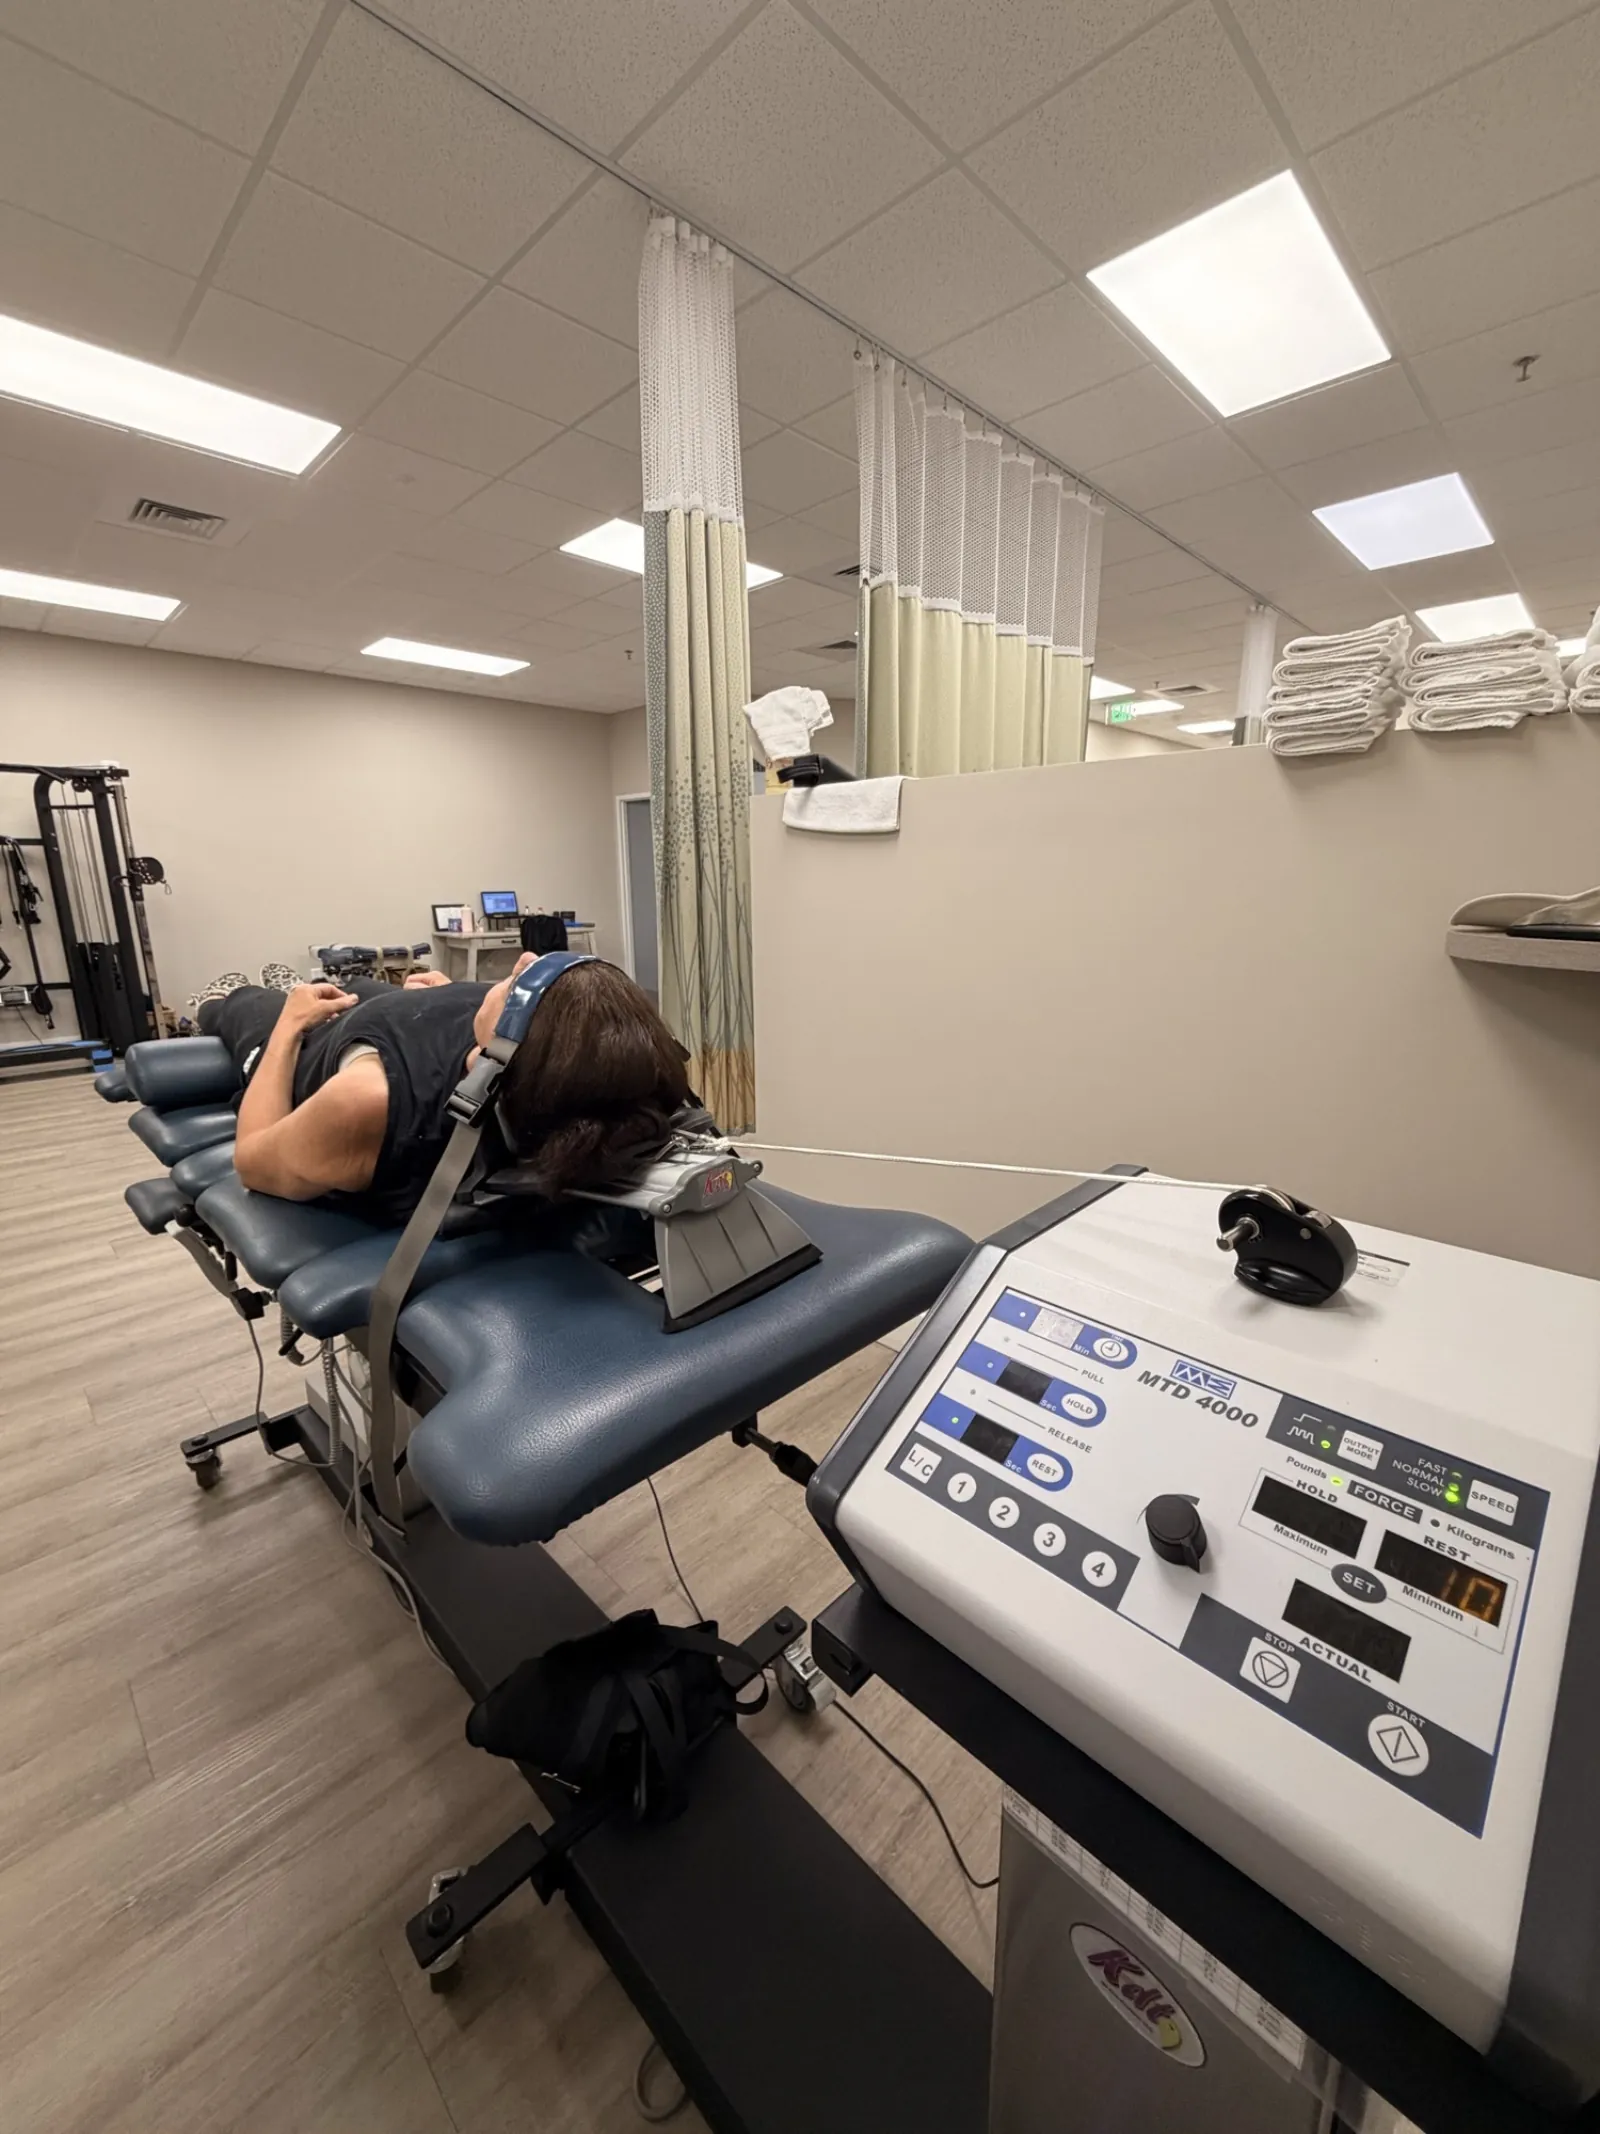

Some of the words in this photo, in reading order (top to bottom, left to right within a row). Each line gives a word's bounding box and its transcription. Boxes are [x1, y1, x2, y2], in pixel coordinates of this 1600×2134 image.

[1073, 1343, 1091, 1357] Min
[1080, 1369, 1105, 1385] PULL
[1039, 1398, 1058, 1413] Sec
[1065, 1397, 1093, 1415] HOLD
[1136, 1370, 1191, 1400] MTD
[1194, 1396, 1259, 1428] 4000
[1047, 1426, 1093, 1454] RELEASE
[1343, 1436, 1380, 1456] OUTPUT
[907, 1450, 934, 1477] L/C
[1345, 1446, 1374, 1462] MODE
[1004, 1459, 1022, 1474] Sec
[1030, 1458, 1059, 1478] REST
[1286, 1455, 1327, 1480] Pounds
[1391, 1459, 1446, 1487] NORMAL
[1416, 1457, 1448, 1476] FAST
[955, 1480, 967, 1495] 1
[1295, 1479, 1338, 1504] HOLD
[1406, 1476, 1443, 1498] SLOW
[995, 1504, 1011, 1521] 2
[1353, 1484, 1416, 1520] FORCE
[1470, 1489, 1516, 1515] SPEED
[1042, 1531, 1057, 1548] 3
[1273, 1523, 1329, 1557] Maximum
[1423, 1535, 1471, 1562] REST
[1446, 1523, 1516, 1561] Kilograms
[1090, 1559, 1107, 1579] 4
[1341, 1571, 1376, 1595] SET
[1401, 1584, 1465, 1622] Minimum
[1441, 1568, 1501, 1625] 10
[1264, 1631, 1296, 1654] STOP
[1298, 1635, 1373, 1684] ACTUAL
[1386, 1700, 1426, 1728] START
